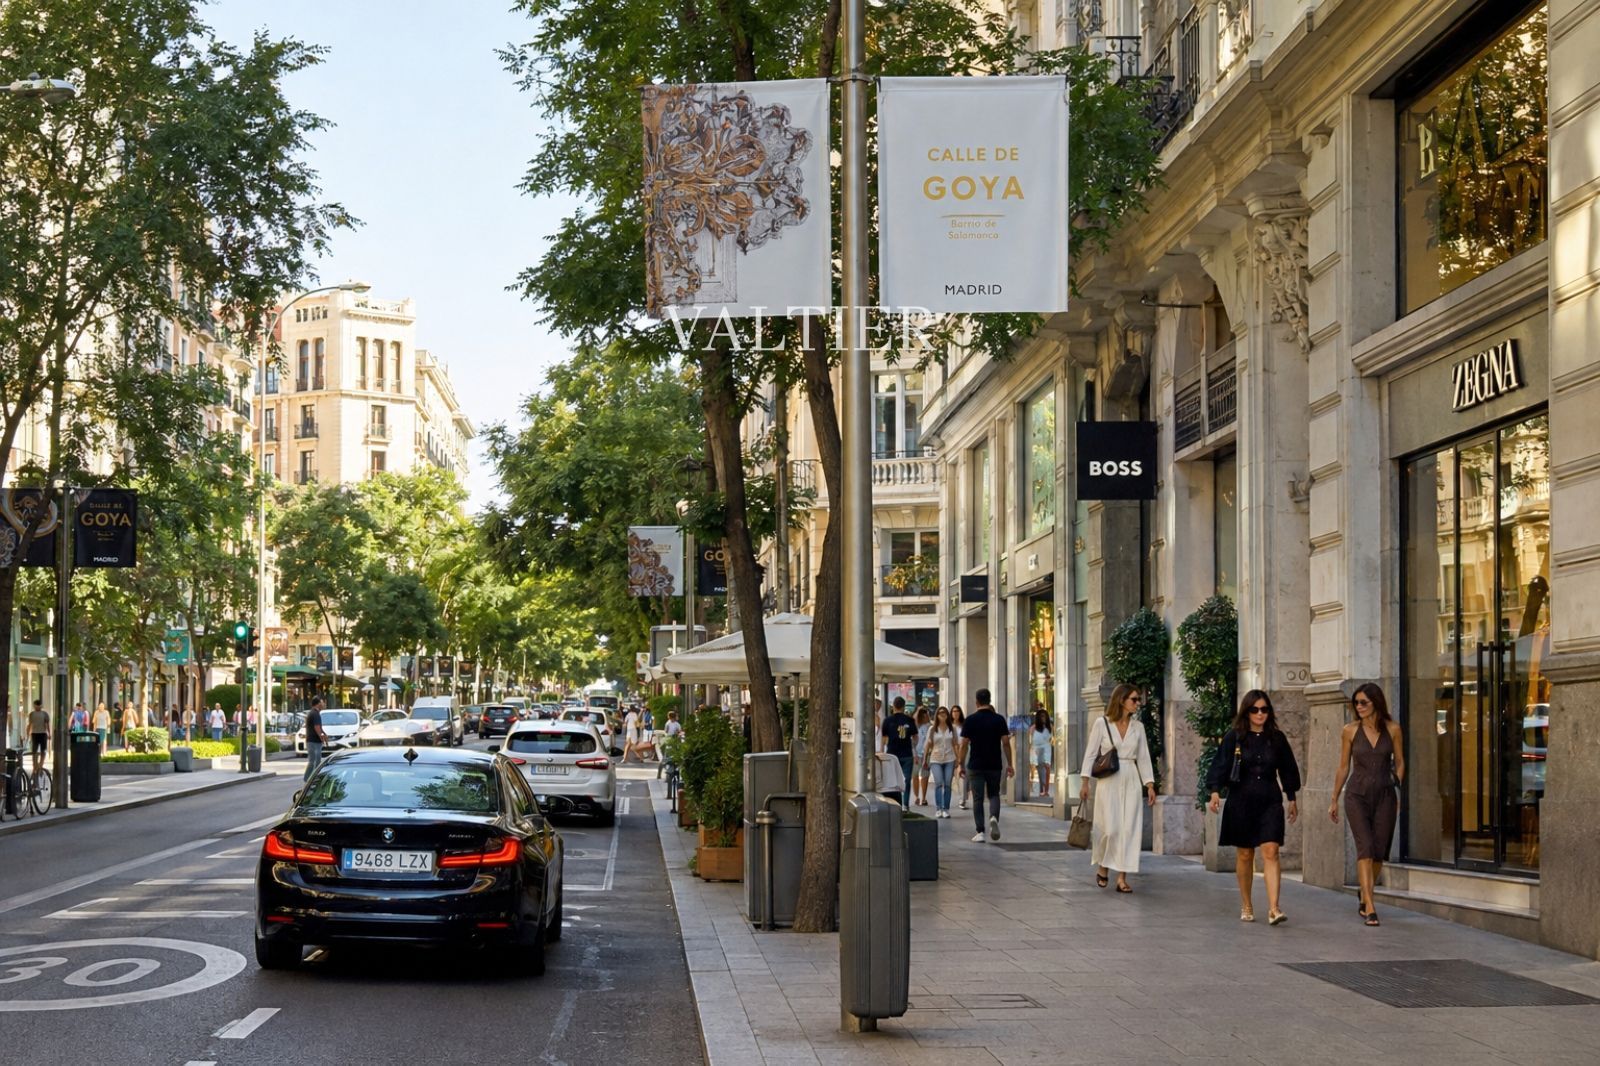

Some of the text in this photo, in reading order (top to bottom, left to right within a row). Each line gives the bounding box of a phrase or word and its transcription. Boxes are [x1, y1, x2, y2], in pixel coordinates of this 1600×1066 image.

[927, 147, 1019, 162] CALLE DE
[922, 175, 1025, 201] GOYA
[951, 220, 997, 229] Barrio de
[948, 231, 999, 240] Salamanca
[944, 284, 1002, 296] MADRID
[1451, 339, 1519, 409] ZEGNA
[1089, 460, 1143, 477] BOSS
[80, 512, 132, 527] GOYA
[704, 550, 726, 562] GO
[354, 852, 428, 869] 9468 LZX
[0, 956, 161, 987] 30
